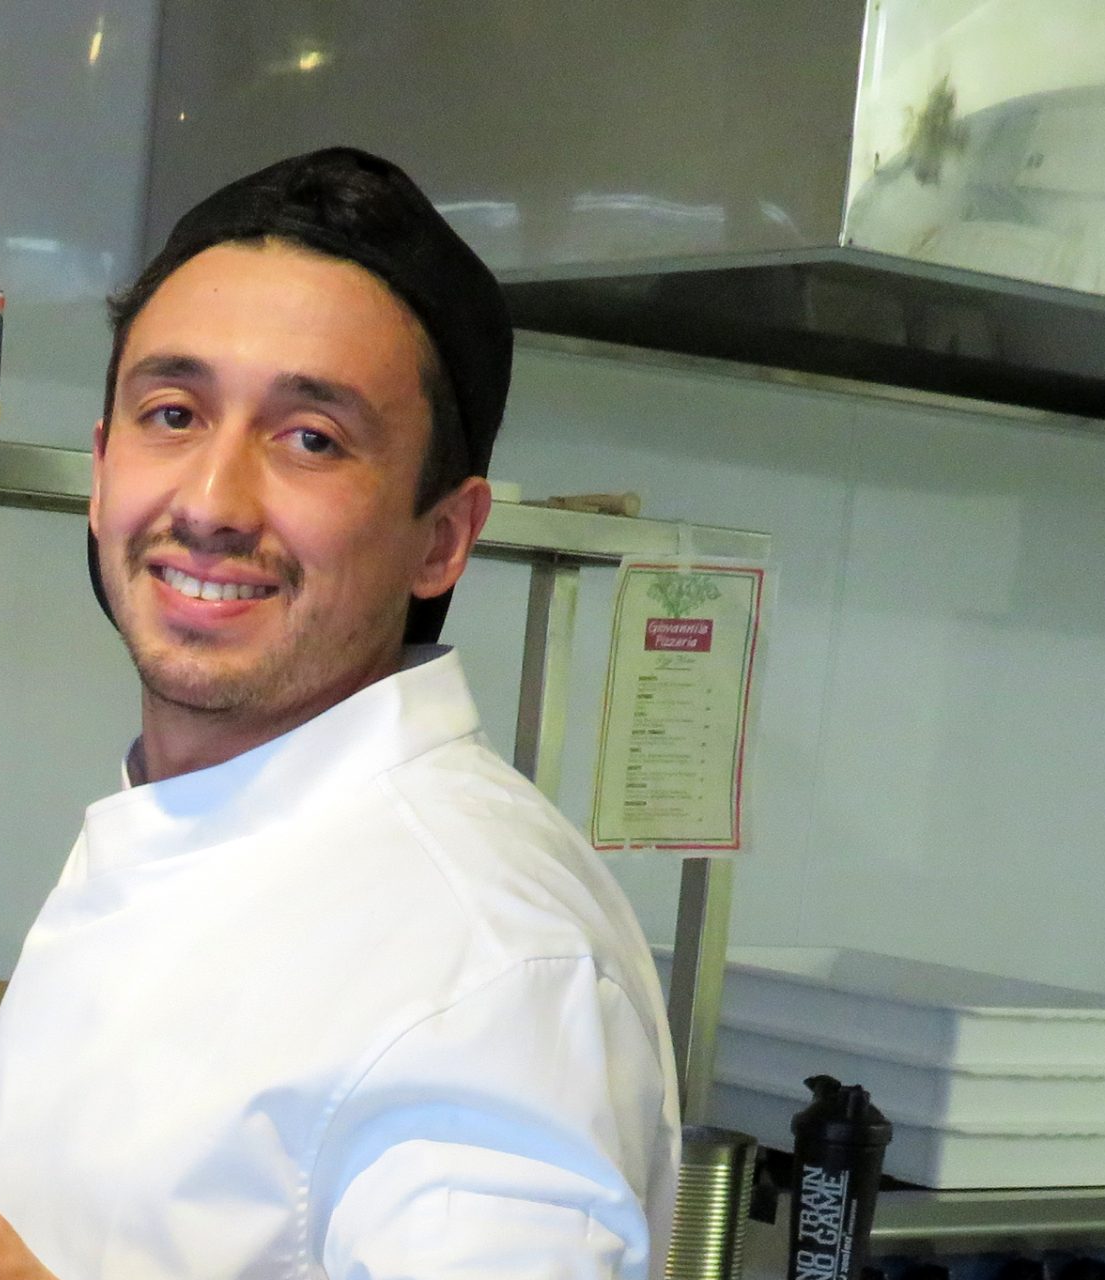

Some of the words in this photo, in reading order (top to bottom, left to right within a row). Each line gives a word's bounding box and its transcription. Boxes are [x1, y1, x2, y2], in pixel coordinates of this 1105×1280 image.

[655, 635, 698, 648] Pizzeria
[799, 1164, 823, 1241] TRAIN
[816, 1173, 843, 1245] GAME
